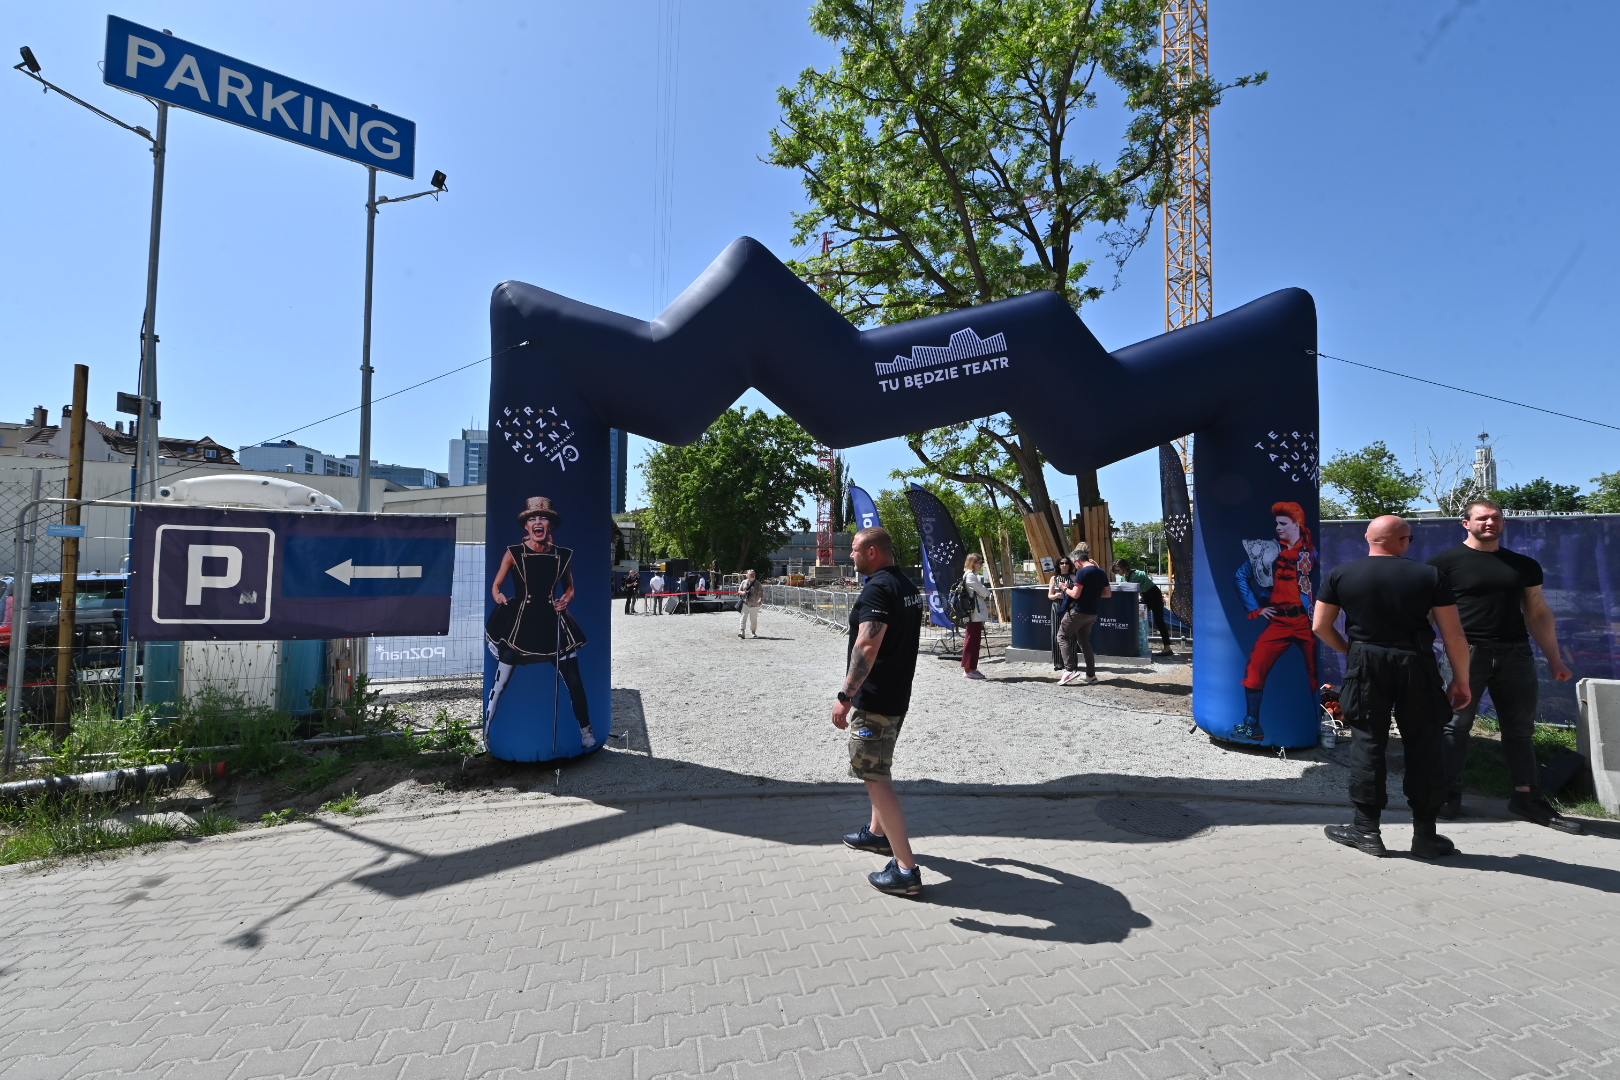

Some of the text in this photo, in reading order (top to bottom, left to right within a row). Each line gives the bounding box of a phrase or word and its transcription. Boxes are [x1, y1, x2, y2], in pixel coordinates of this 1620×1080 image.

[125, 34, 401, 160] PARKING
[879, 356, 1009, 392] TU BĘDZIE TEATR
[186, 544, 243, 605] P
